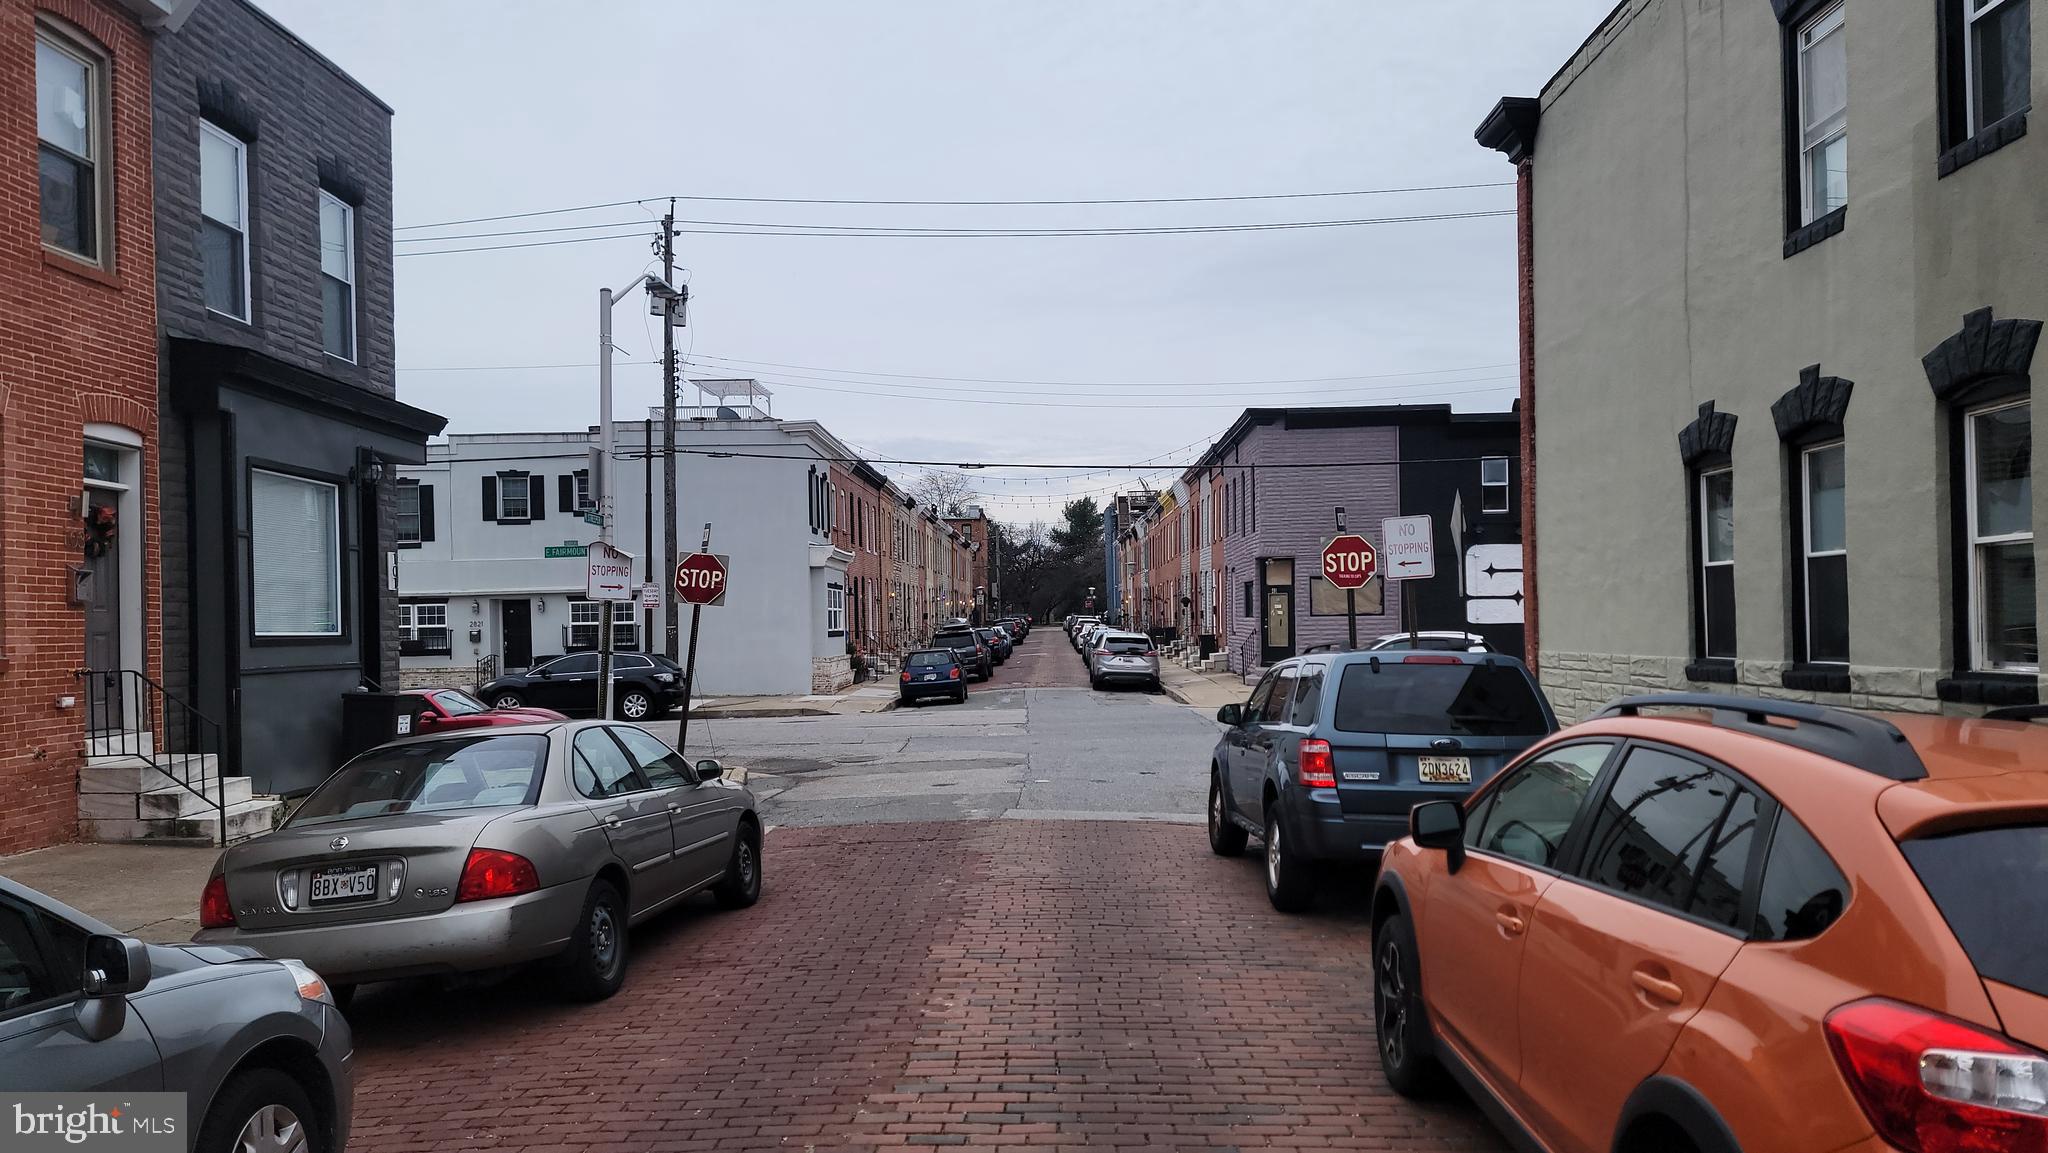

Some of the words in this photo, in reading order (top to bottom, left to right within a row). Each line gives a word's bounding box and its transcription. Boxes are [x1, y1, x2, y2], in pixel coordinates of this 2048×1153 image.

[1398, 523, 1416, 537] NO
[545, 548, 551, 557] E
[603, 546, 619, 559] NO
[1387, 542, 1429, 555] STOPPING
[1325, 551, 1373, 573] STOP
[591, 564, 629, 577] STOPPING
[678, 568, 723, 589] STOP
[1421, 762, 1468, 777] 2DN3624
[313, 878, 340, 897] 8BX
[349, 874, 375, 893] V50
